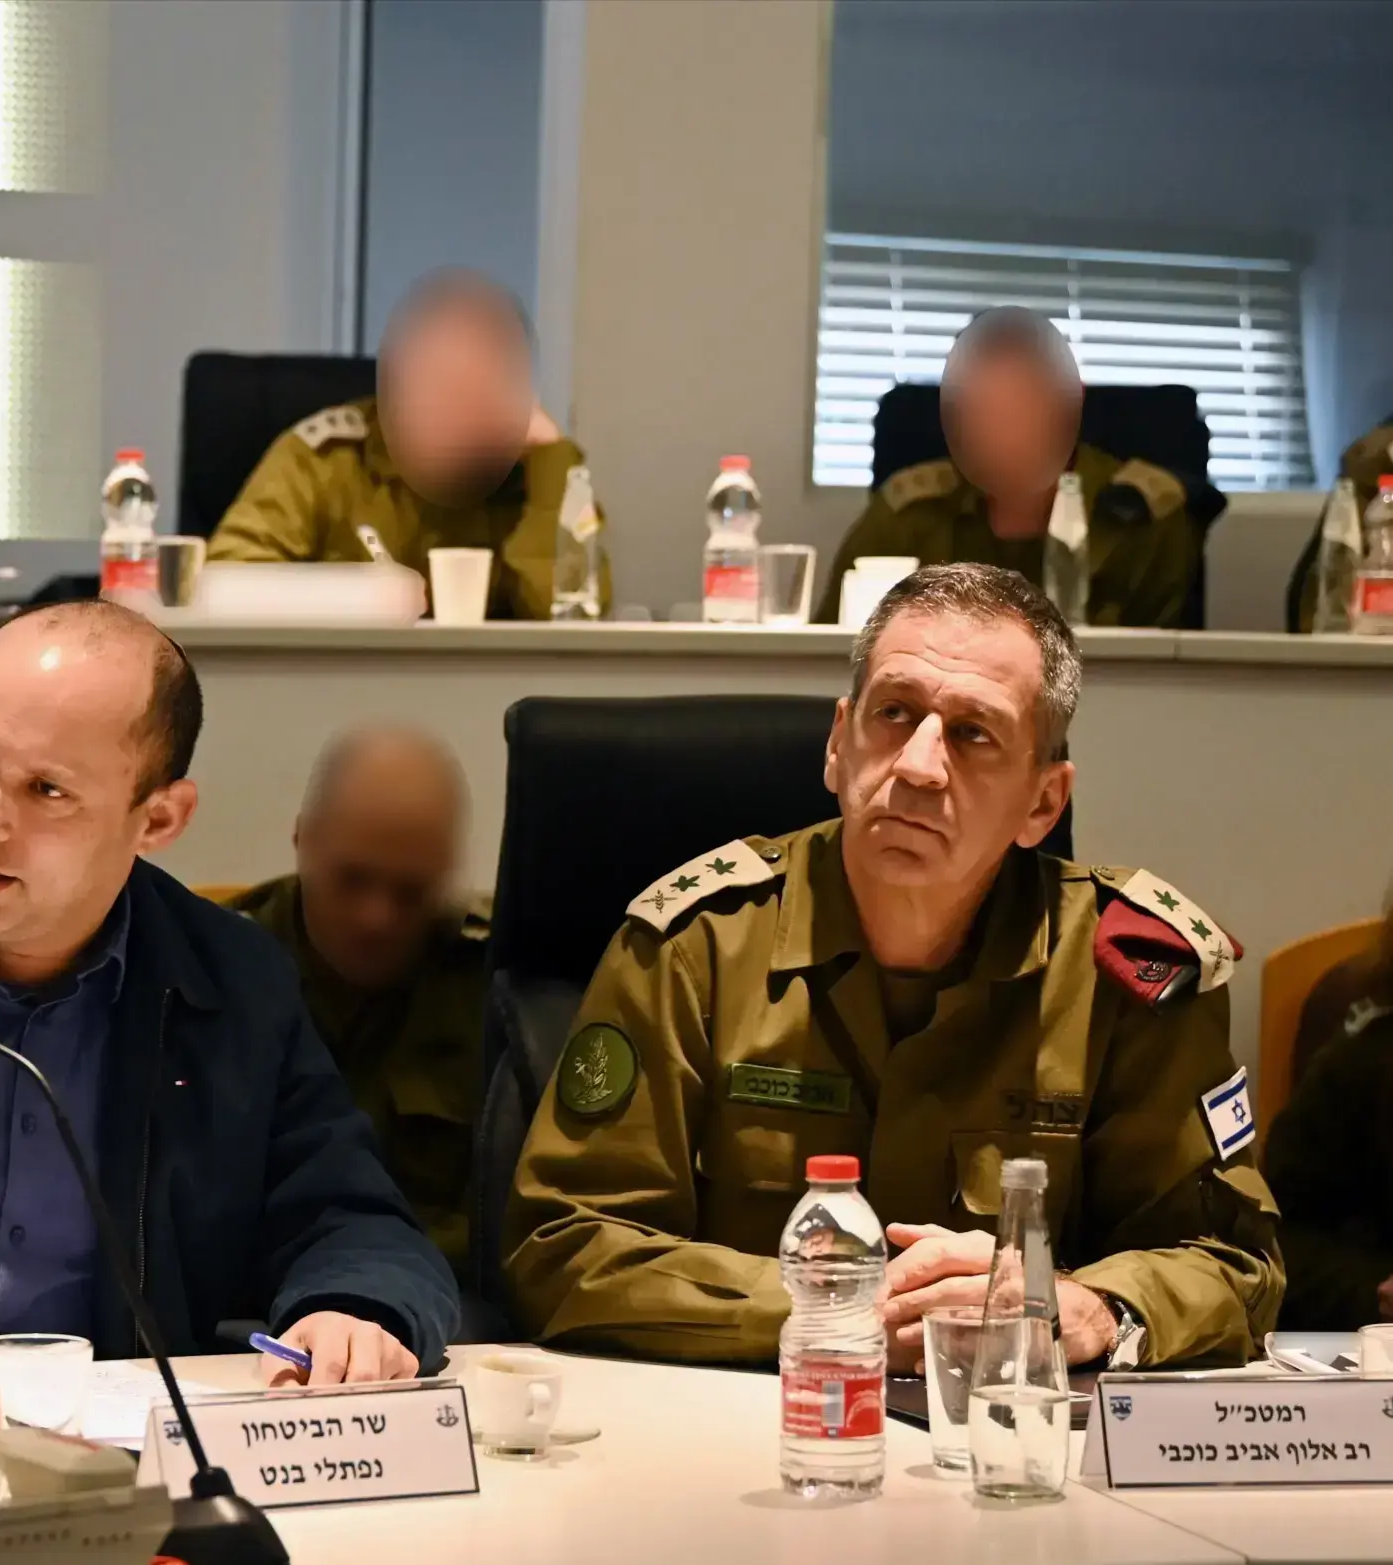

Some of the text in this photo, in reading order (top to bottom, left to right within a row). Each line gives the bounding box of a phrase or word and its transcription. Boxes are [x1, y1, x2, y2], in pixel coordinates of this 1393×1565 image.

[1214, 1400, 1306, 1423] רמטכ"ל
[240, 1414, 387, 1448] שר הביטחון
[1158, 1438, 1371, 1465] רב אלוף אביב כוכבי
[259, 1457, 384, 1487] נפתלי בנט
